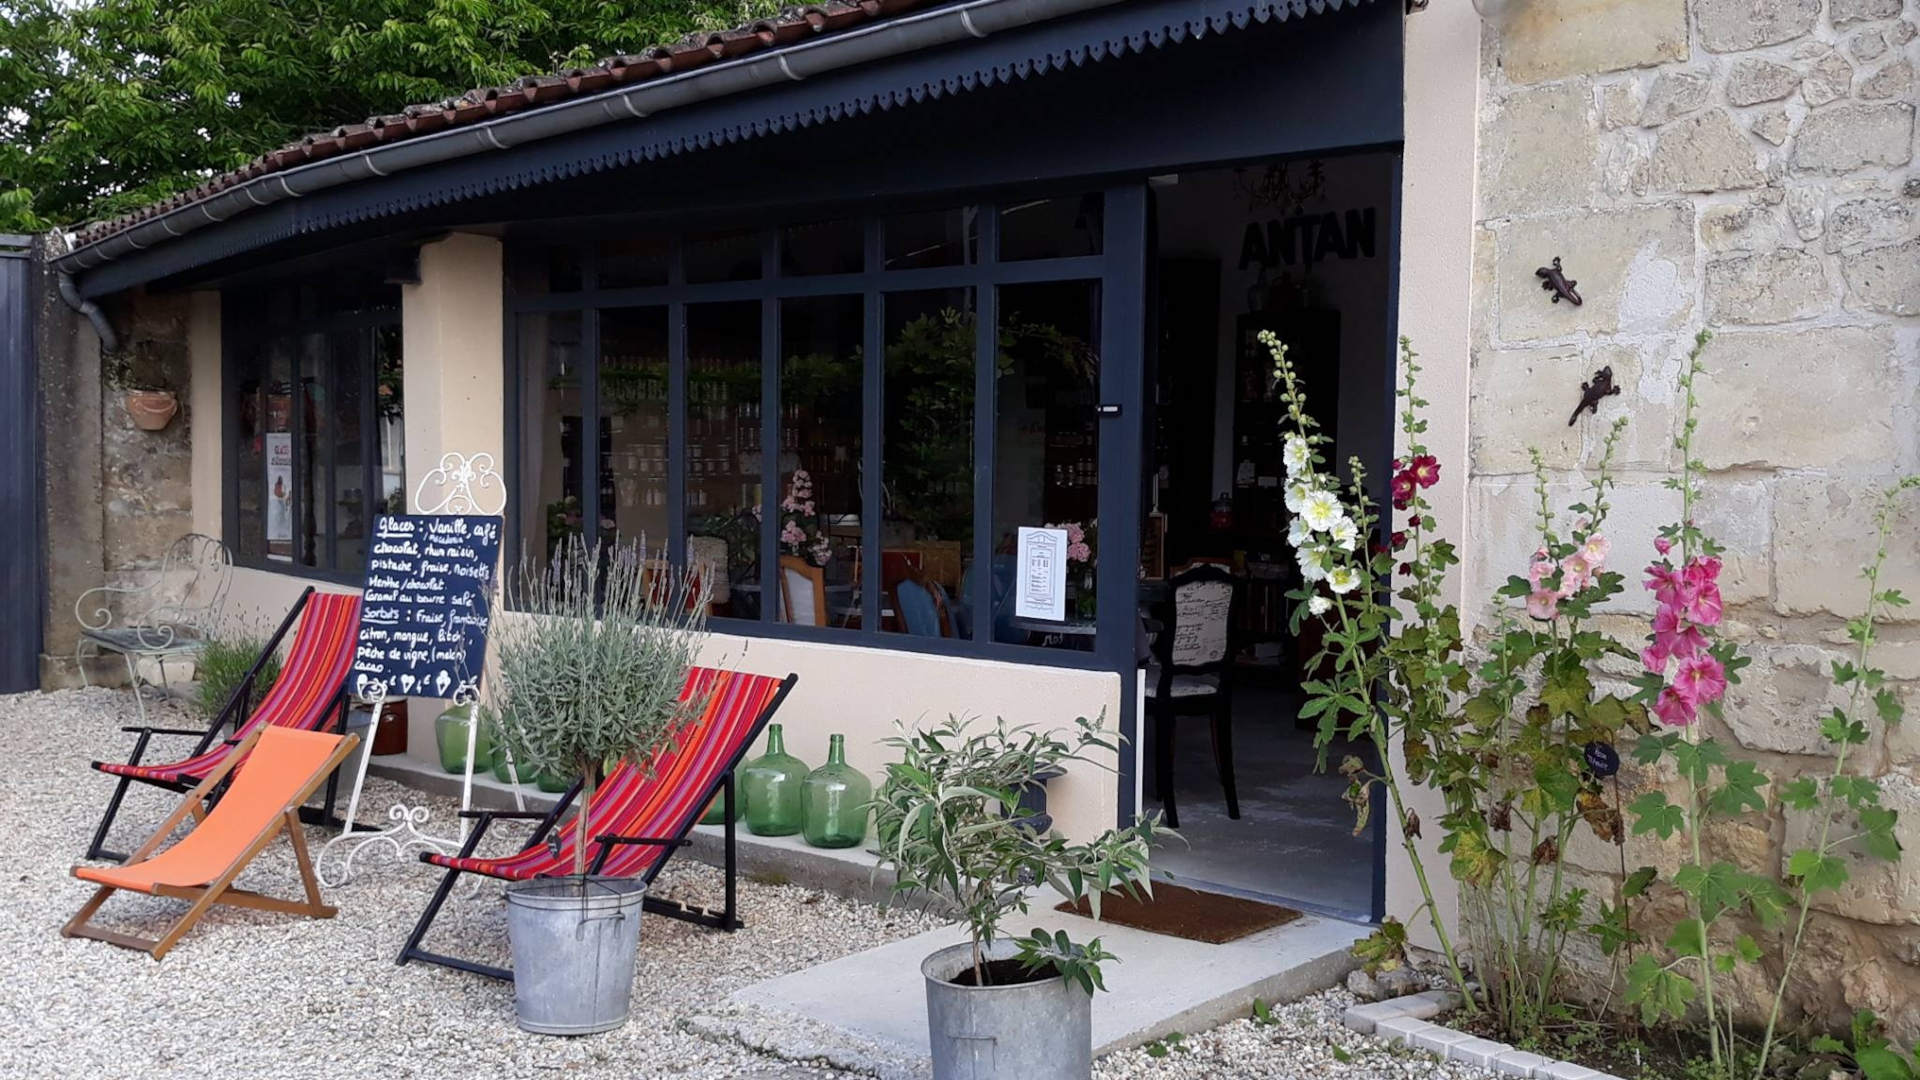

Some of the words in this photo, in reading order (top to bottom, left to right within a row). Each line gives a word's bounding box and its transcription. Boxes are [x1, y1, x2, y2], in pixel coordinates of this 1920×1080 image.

[1238, 207, 1376, 271] ANTAN
[400, 594, 412, 603] au
[389, 648, 400, 660] de
